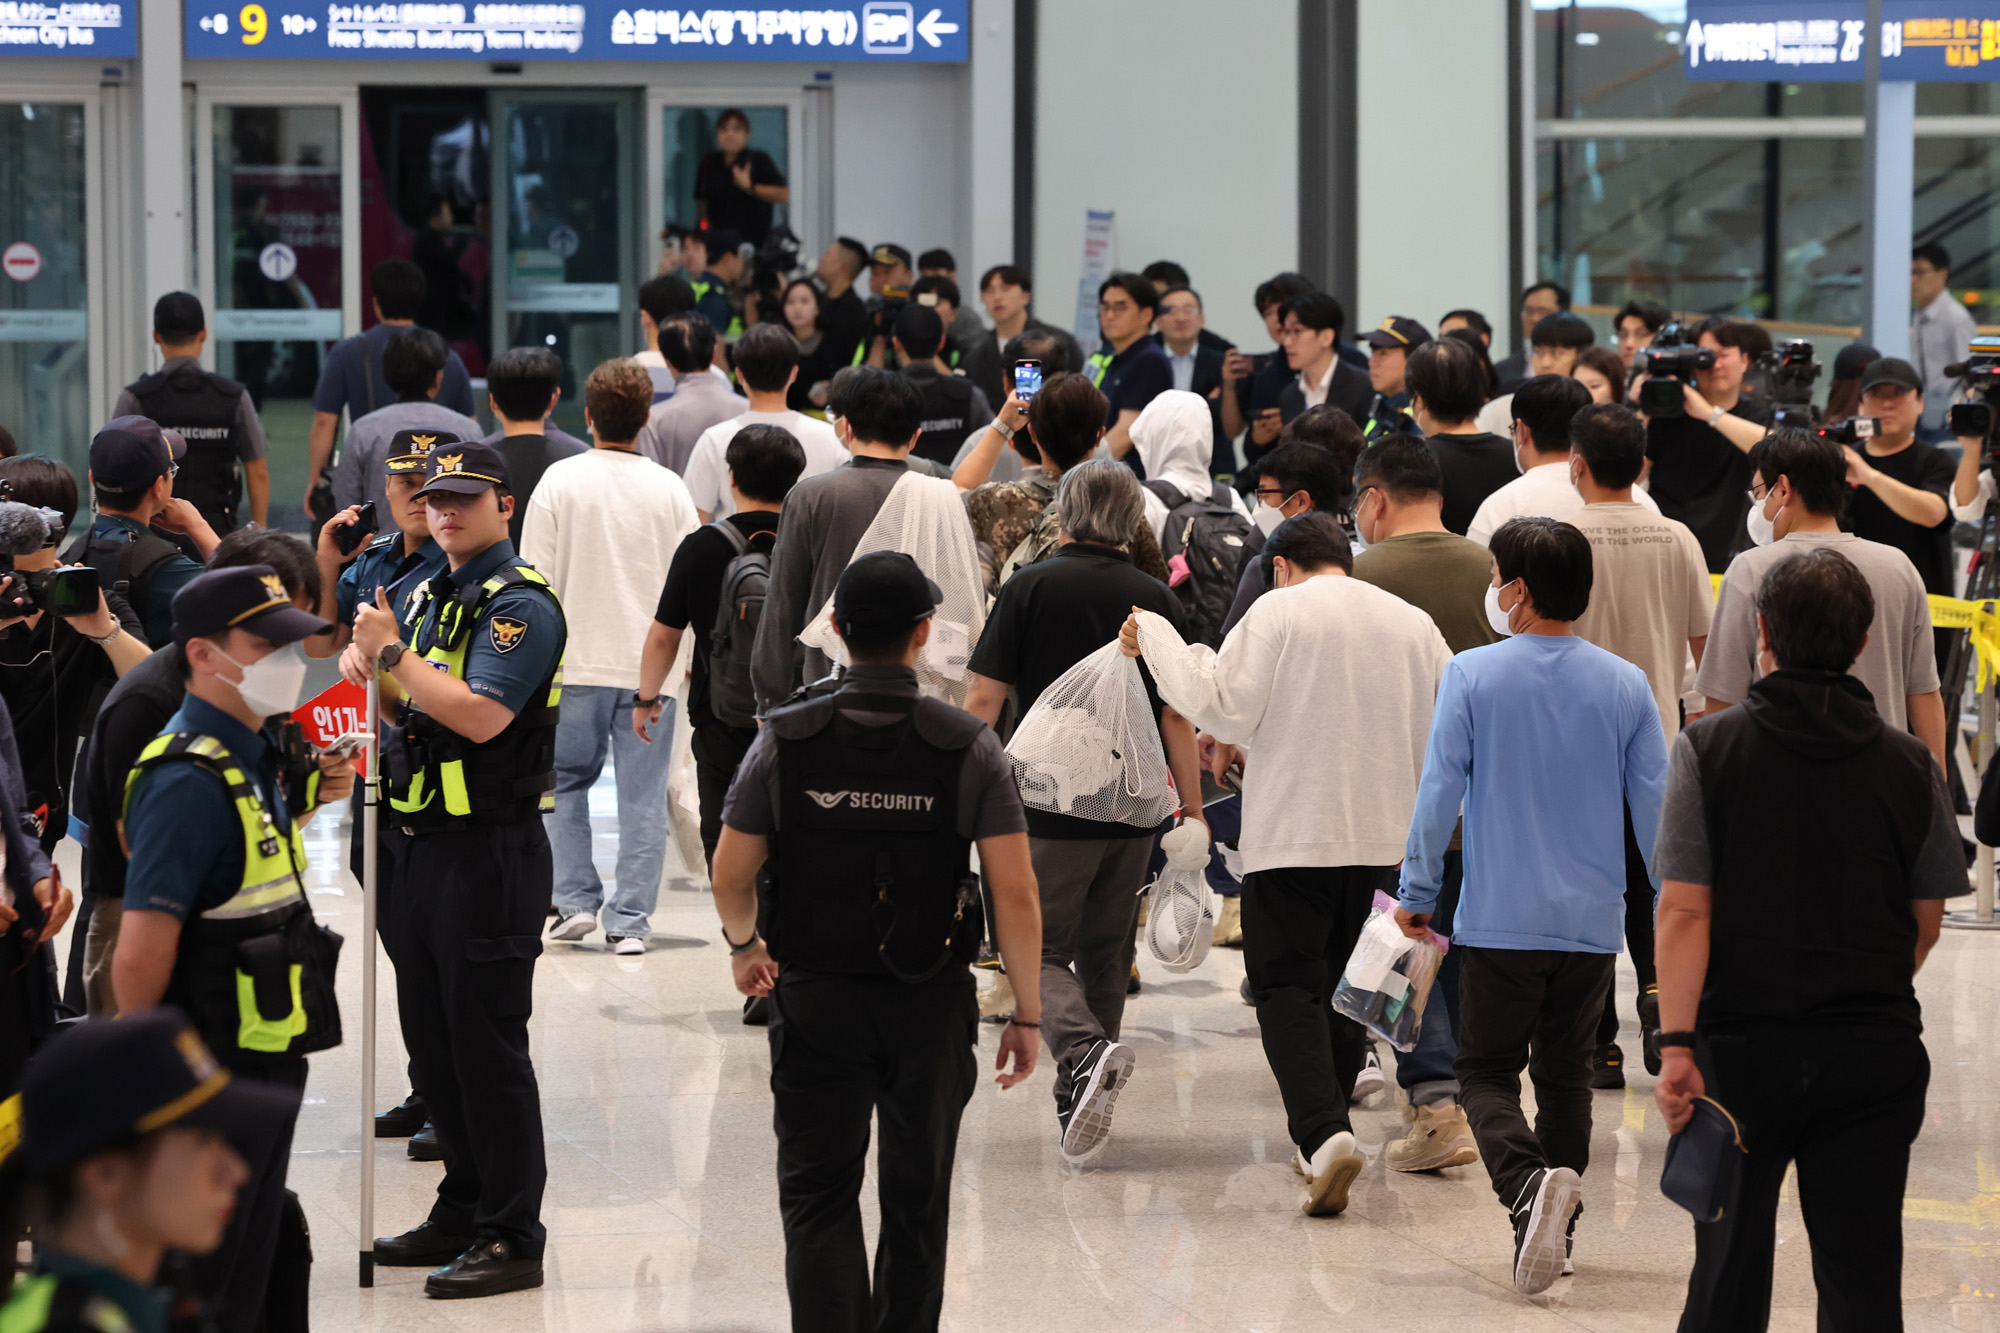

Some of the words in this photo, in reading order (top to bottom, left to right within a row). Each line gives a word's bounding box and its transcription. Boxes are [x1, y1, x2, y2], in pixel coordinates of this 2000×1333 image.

[213, 13, 229, 34] 8
[240, 4, 268, 45] 9
[281, 14, 304, 35] 10
[1606, 527, 1629, 535] THE
[1606, 537, 1629, 545] THE
[1631, 536, 1673, 544] WORLD
[849, 791, 935, 811] SECURITY
